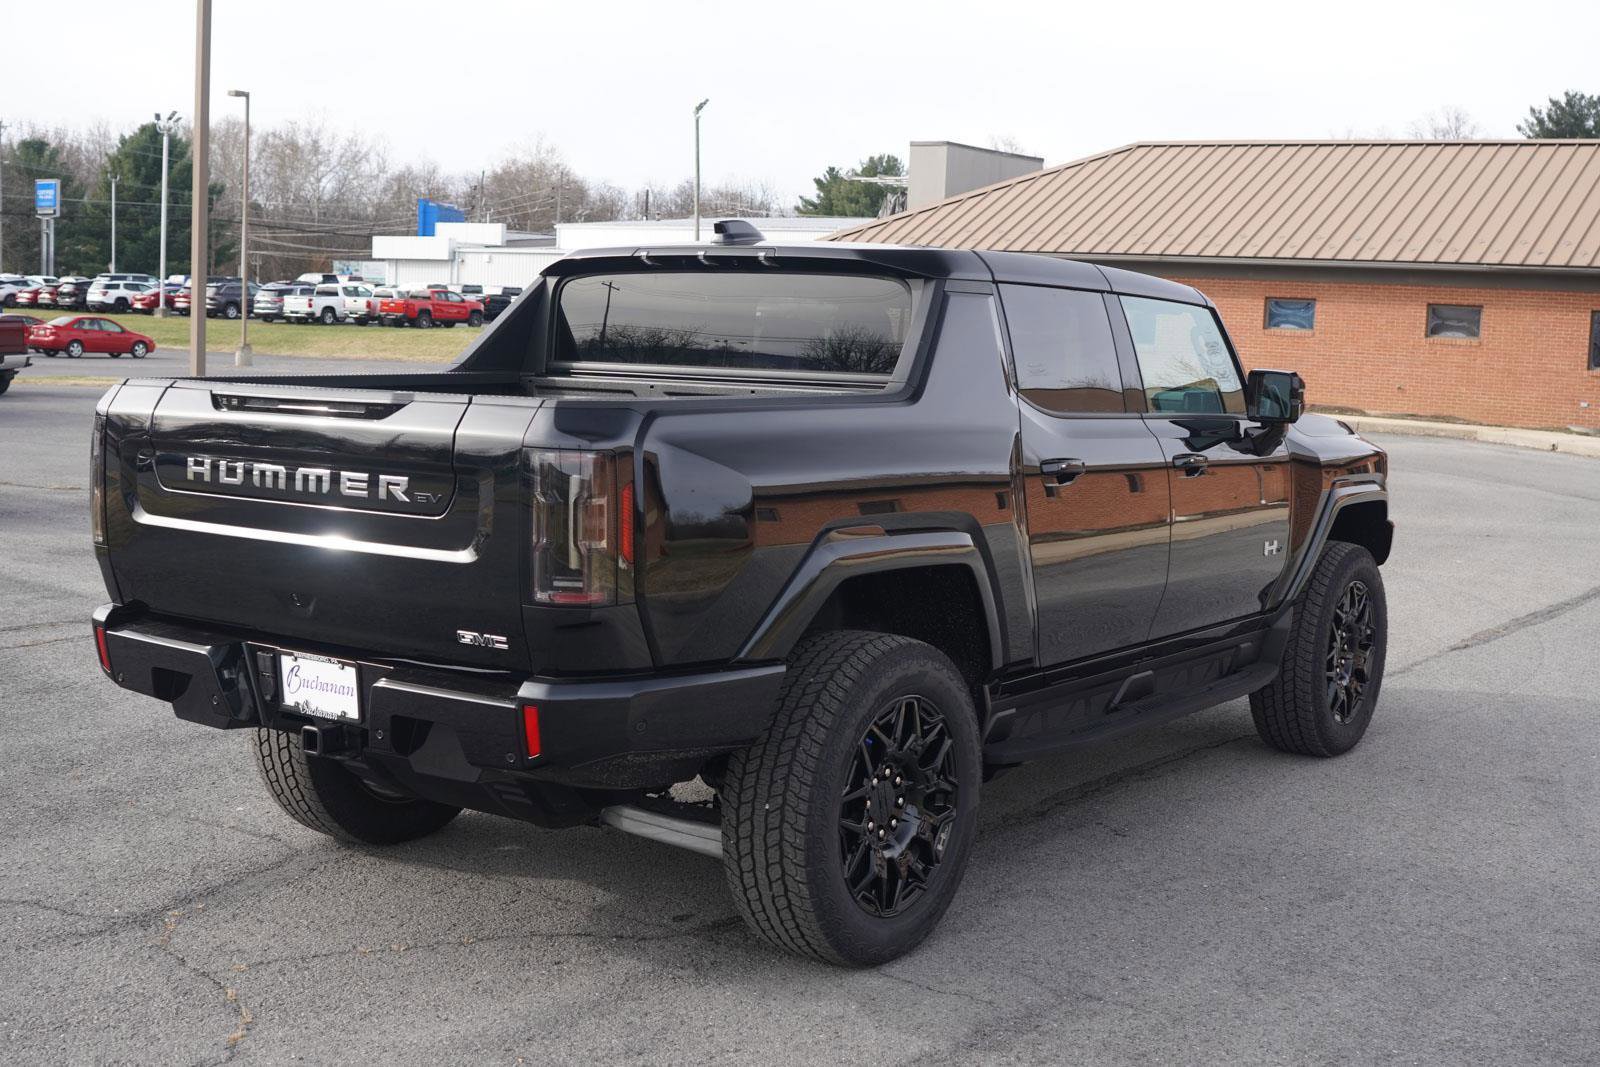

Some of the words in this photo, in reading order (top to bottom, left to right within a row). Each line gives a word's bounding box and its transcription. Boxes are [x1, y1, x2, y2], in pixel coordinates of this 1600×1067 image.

[187, 457, 410, 502] HUMMER
[413, 492, 442, 503] EV
[457, 630, 509, 650] GMC
[287, 664, 354, 697] Buchanan
